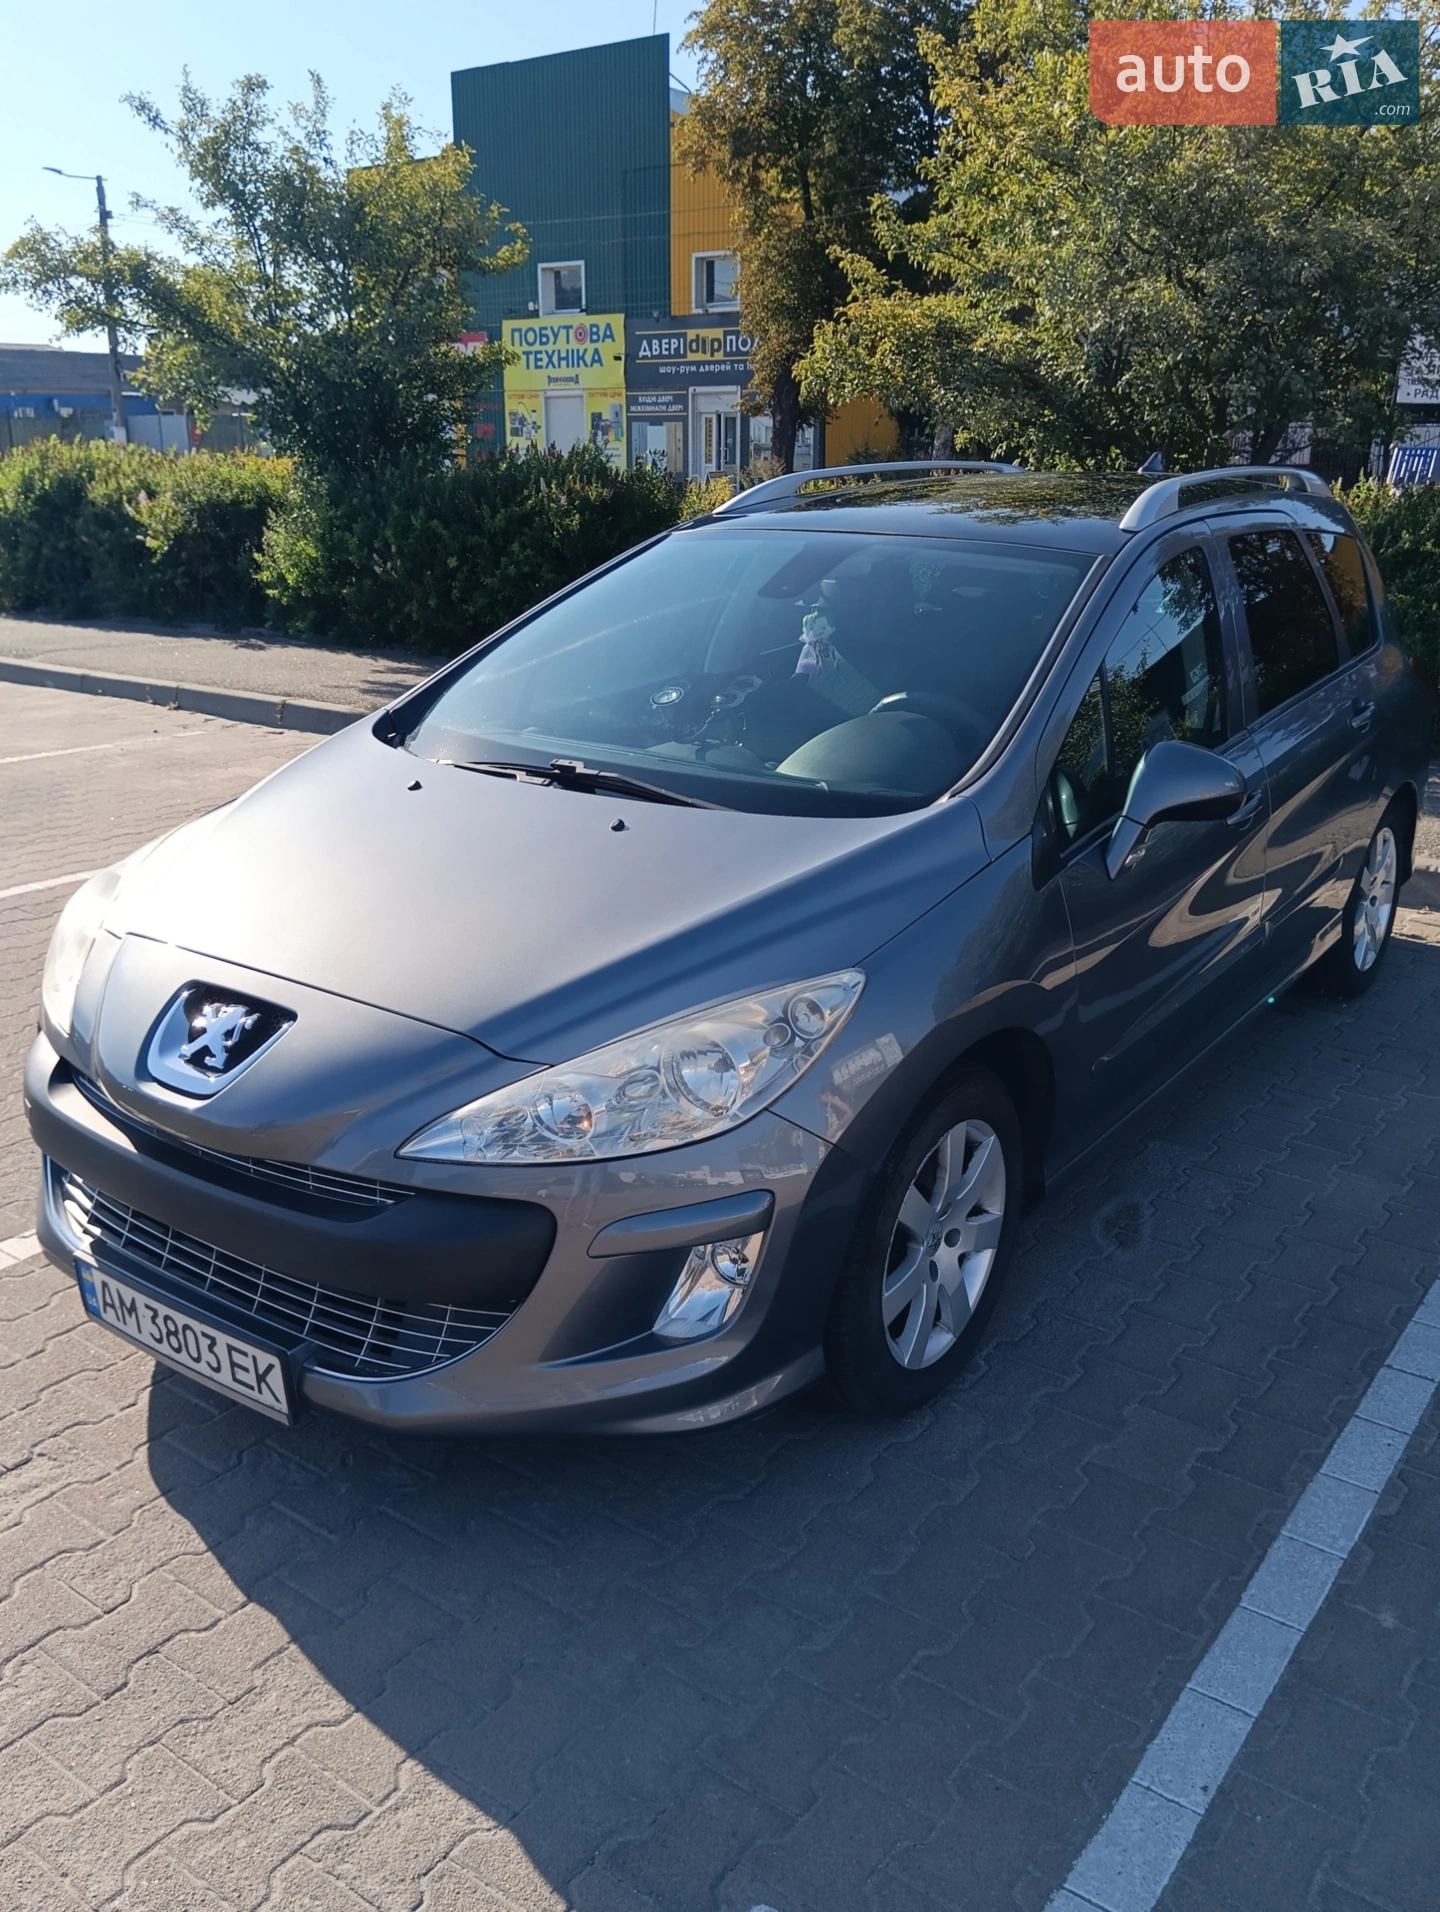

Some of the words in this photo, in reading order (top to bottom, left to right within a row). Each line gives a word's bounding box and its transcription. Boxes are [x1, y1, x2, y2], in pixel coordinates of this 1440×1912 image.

[510, 322, 616, 347] ПОБУТОВА
[638, 337, 684, 358] ДВЕРІ
[522, 347, 604, 370] ТЕХНІКА
[659, 364, 697, 375] шоу-рум
[698, 362, 731, 373] дверей
[733, 362, 744, 370] та
[638, 395, 657, 403] ВХІДНІ
[657, 394, 673, 403] ДВЕРІ
[667, 404, 684, 412] ДВЕРІ
[86, 1293, 99, 1310] UA
[101, 1279, 142, 1334] AM
[144, 1302, 222, 1374] 3803
[226, 1342, 282, 1405] EK
